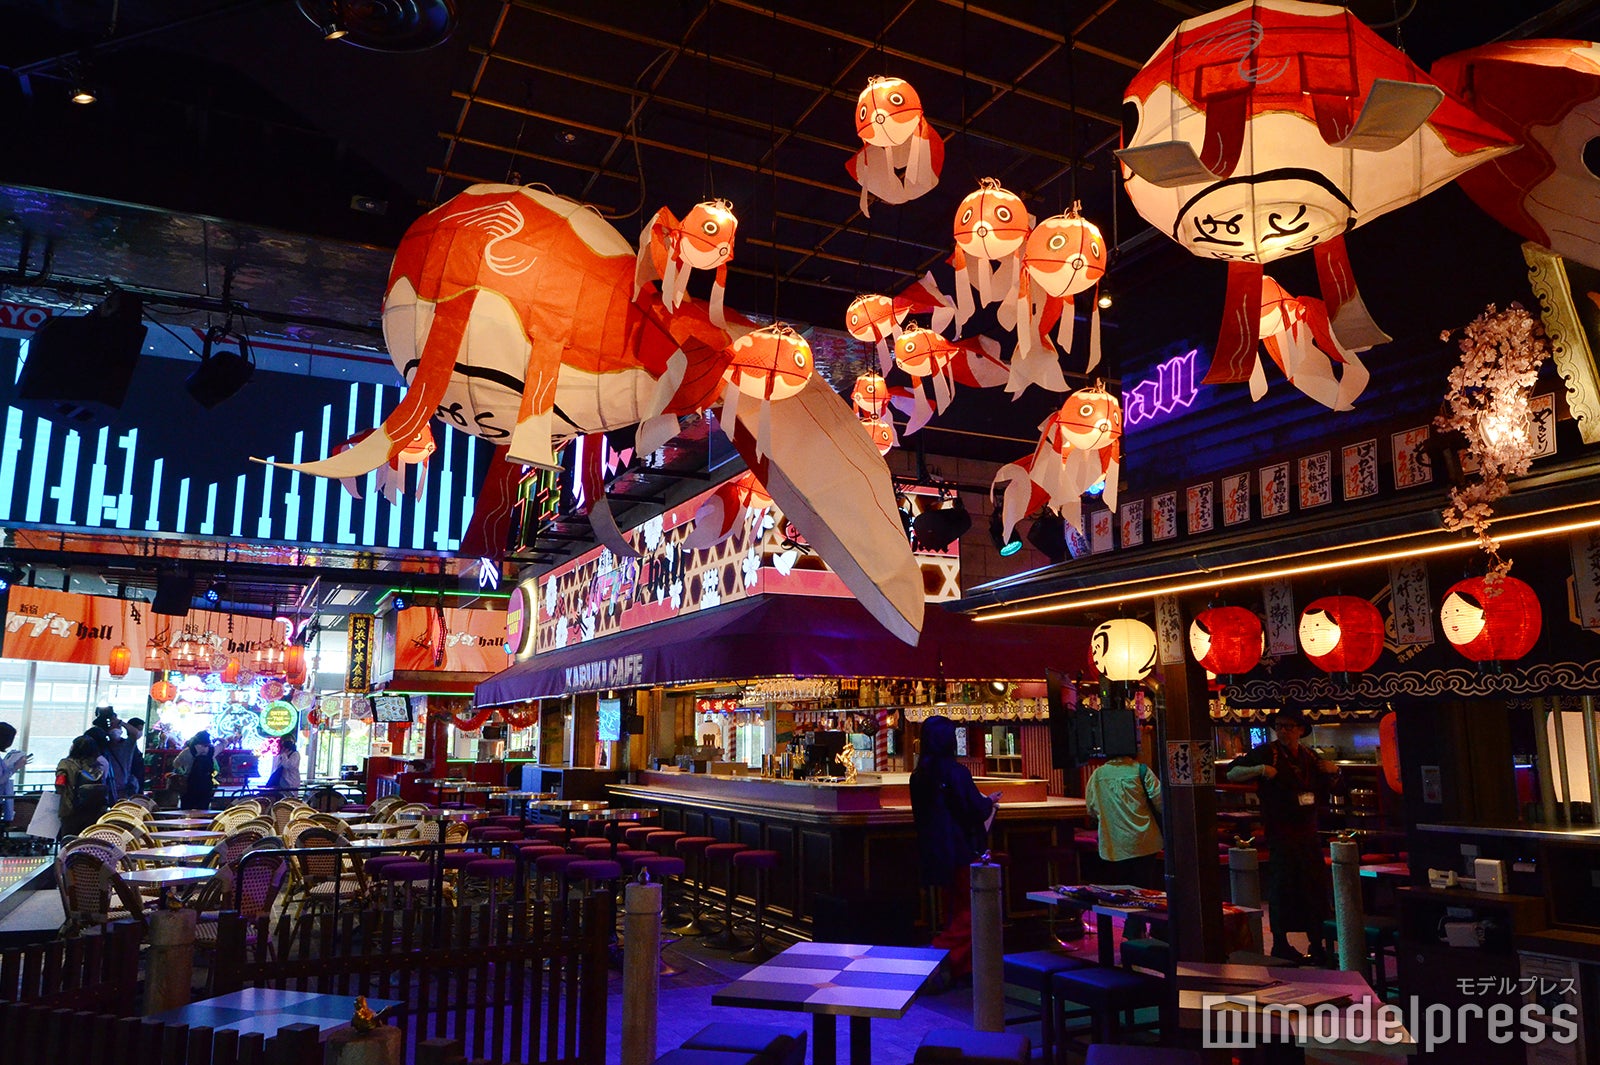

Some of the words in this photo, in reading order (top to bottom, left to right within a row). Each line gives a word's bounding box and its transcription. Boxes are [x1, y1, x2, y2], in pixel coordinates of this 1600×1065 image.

[0, 304, 47, 328] YO
[76, 621, 113, 640] hall
[478, 636, 505, 647] hall
[565, 660, 607, 692] KABUKI
[608, 653, 643, 685] CAFE
